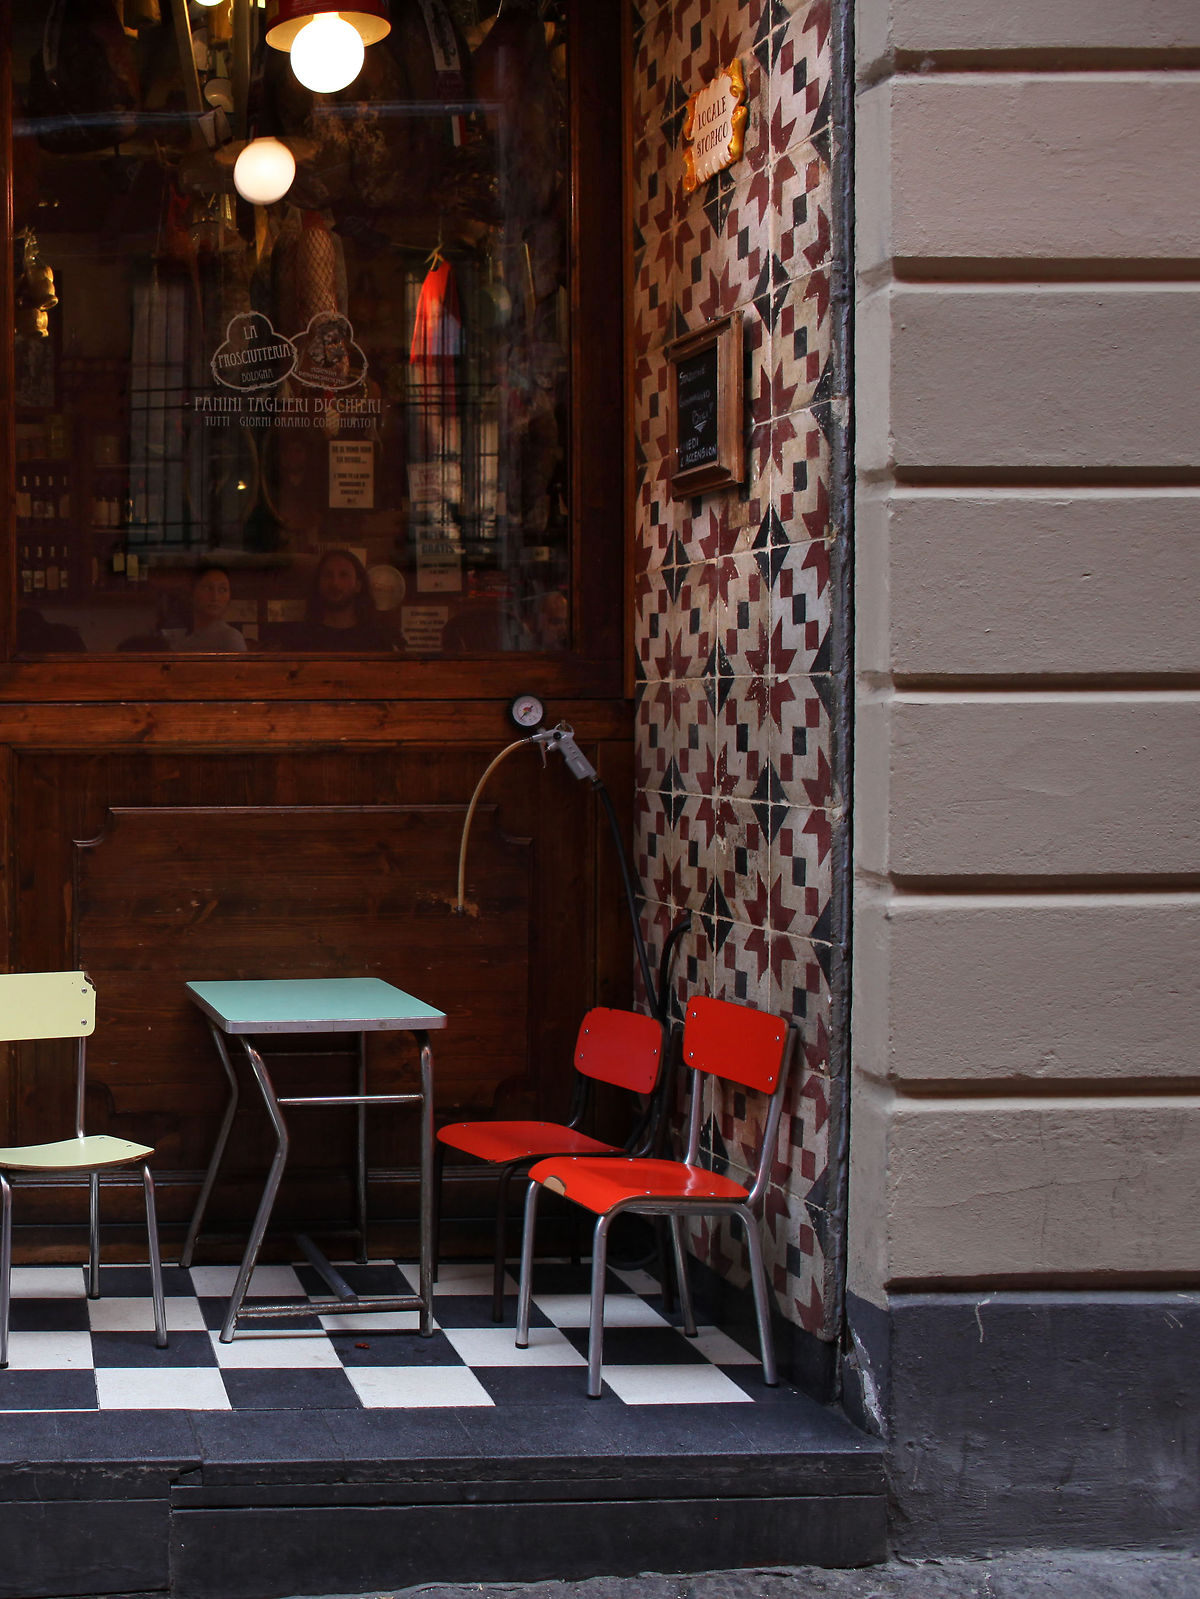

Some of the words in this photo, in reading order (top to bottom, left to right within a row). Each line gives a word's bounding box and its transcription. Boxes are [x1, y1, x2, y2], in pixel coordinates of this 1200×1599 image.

[698, 96, 727, 130] LOCALE
[697, 121, 729, 158] STORICO
[243, 325, 259, 340] LA
[217, 343, 290, 369] PROSCIUTTERIA
[240, 368, 274, 382] BOLOGNA
[194, 396, 241, 412] PANINI
[247, 396, 309, 413] TAGLIERI
[314, 397, 382, 414] BICCHIERI
[204, 415, 230, 427] TUTTI
[313, 416, 371, 429] CONUATO
